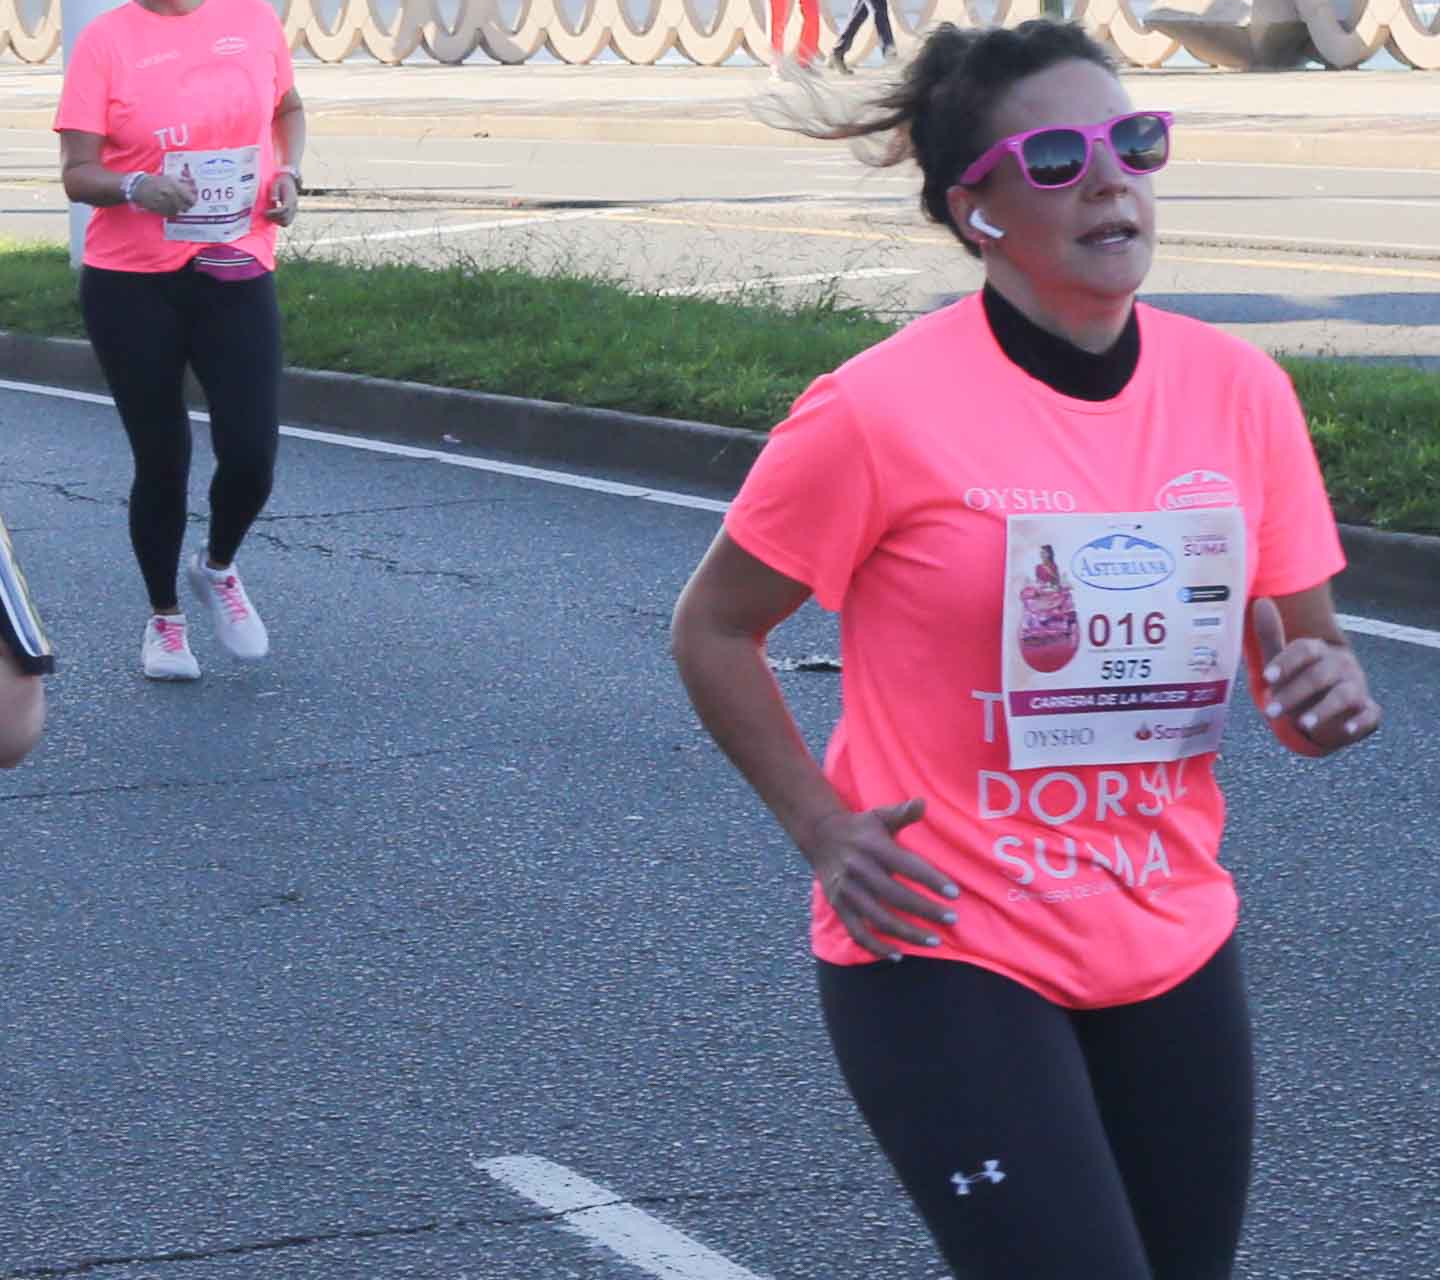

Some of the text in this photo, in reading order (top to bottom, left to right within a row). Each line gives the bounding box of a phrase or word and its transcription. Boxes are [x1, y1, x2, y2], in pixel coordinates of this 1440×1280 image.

[154, 124, 190, 150] TU
[201, 186, 234, 201] 016
[963, 488, 1077, 512] OYSHO
[1087, 611, 1167, 647] 016
[1100, 658, 1152, 680] 5975
[1029, 694, 1095, 710] CARRERA
[1096, 693, 1118, 706] DE
[1120, 693, 1138, 705] LA
[1023, 727, 1095, 749] OYSHO
